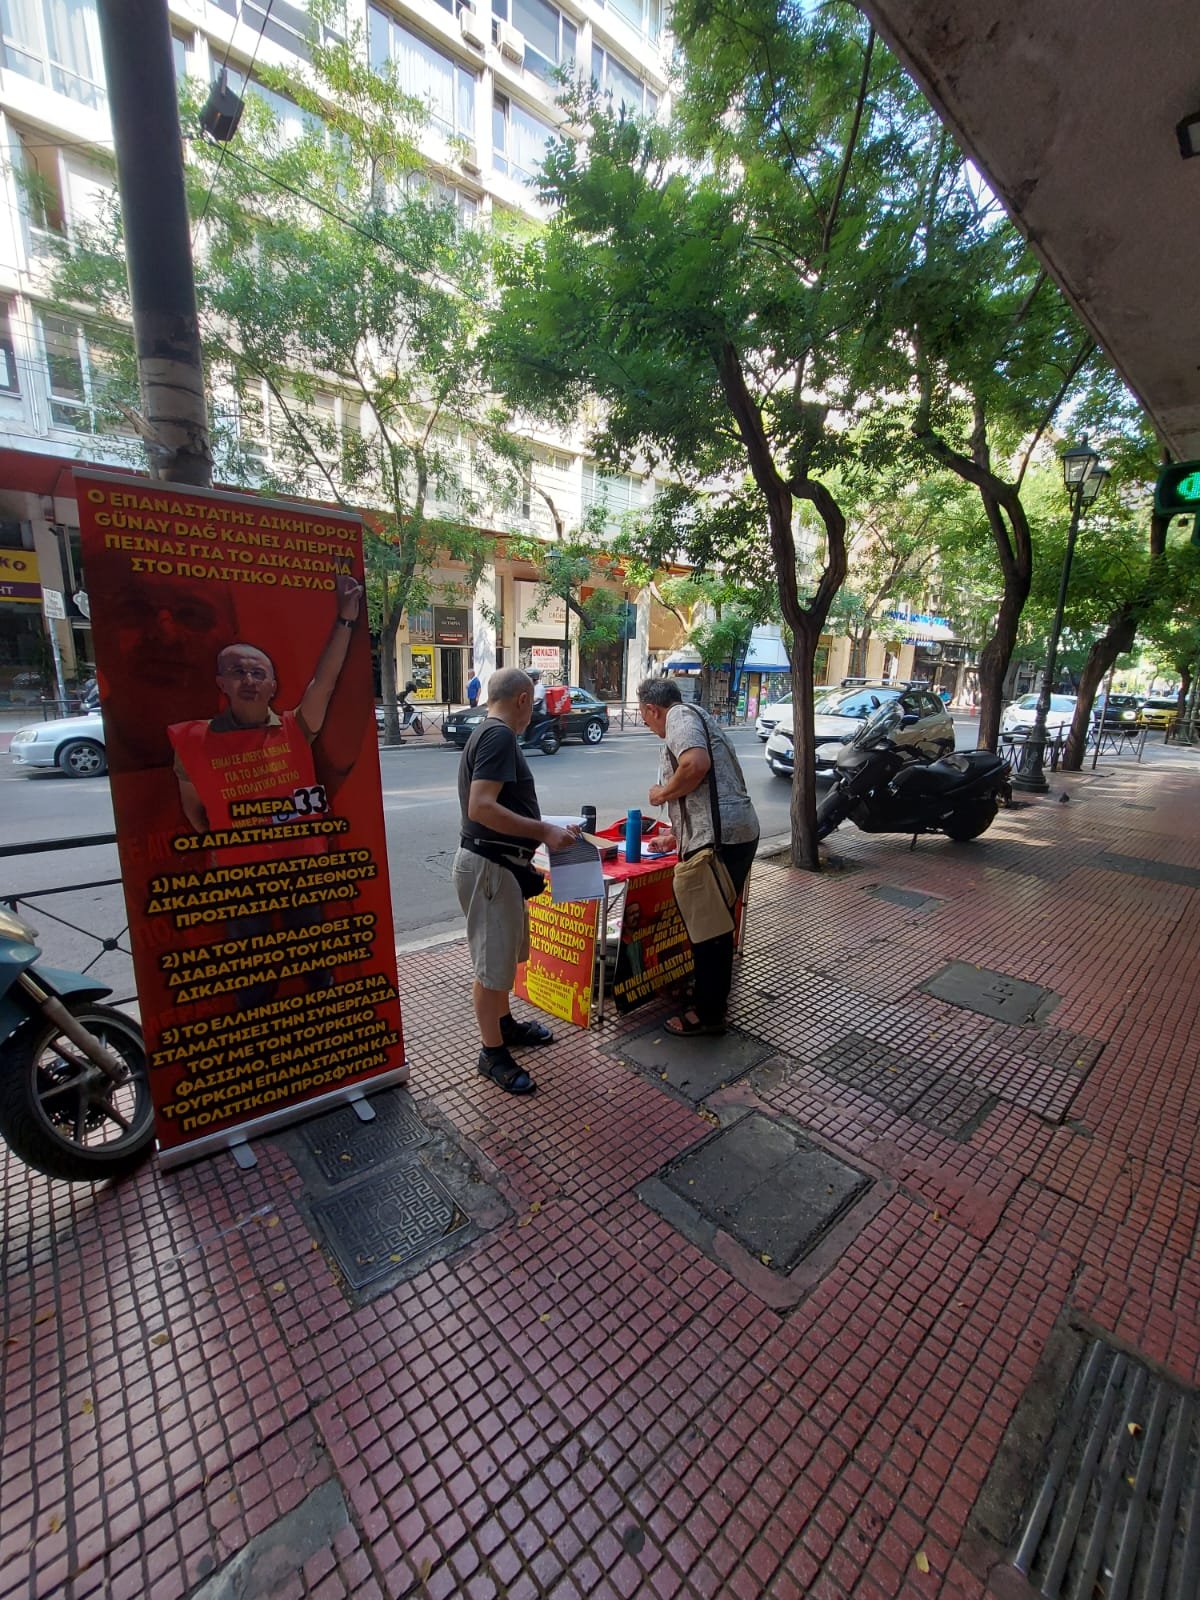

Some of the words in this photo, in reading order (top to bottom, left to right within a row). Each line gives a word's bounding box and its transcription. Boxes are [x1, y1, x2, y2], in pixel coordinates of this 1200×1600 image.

[87, 489, 104, 504] Ο
[110, 492, 255, 527] ΕΠΑΝΑΣΤΑΤΗΣ
[258, 516, 357, 542] ΔΙΚΗΓΟΡΟΣ
[104, 534, 186, 556] ΠΕΙΝΑΣ
[190, 543, 224, 561] ΓΙΑ
[227, 548, 253, 564] ΤΟ
[257, 554, 352, 576] ΔΙΚΑΙΩΜΑ
[221, 528, 281, 548] ΚΑΝΕΙ
[283, 537, 355, 559] ΑΠΕΡΓΙΑ
[132, 556, 173, 575] ΣΤΟ
[177, 562, 276, 585] ΠΟΛΙΤΙΚΟ
[281, 574, 336, 591] ΑΣΥΛΟ
[232, 800, 294, 816] ΗΜΕΡΑ
[174, 835, 199, 850] ΟΙ
[202, 824, 310, 848] ΑΠΑΙΤΗΣΕΙΣ
[313, 820, 348, 833] ΤΟΥ:
[148, 886, 254, 914] ΔΙΚΑΙΩΜΑ
[256, 879, 294, 895] ΤΟΥ,
[295, 865, 376, 889] ΔΙΕΘΝΟΥΣ
[152, 876, 169, 893] 1)
[172, 875, 200, 890] ΝΑ
[203, 855, 347, 886] ΑΠΟΚΑΤΑΣΤΑΘΕΙ
[350, 850, 369, 863] ΤΟ
[176, 897, 290, 928] ΠΡΟΣΤΑΣΙΑΣ
[560, 916, 594, 938] ΚΡΑΤΟΥΣ
[570, 903, 586, 918] ΤΟΥ
[162, 952, 180, 969] 2)
[182, 948, 210, 964] ΝΑ
[212, 940, 249, 957] ΤΟΥ
[252, 919, 350, 950] ΠΑΡΑΔΟΘΕΙ
[354, 914, 374, 928] ΤΟ
[168, 949, 285, 986] ΔΙΑΒΑΤΗΡΙΟ
[286, 942, 320, 959] ΤΟΥ
[322, 936, 351, 950] ΚΑΙ
[353, 930, 374, 944] ΤΟ
[550, 926, 586, 951] ΦΑΣΙΣΜΟ
[176, 970, 278, 1004] ΔΙΚΑΙΩΜΑ
[280, 947, 371, 977] ΔΙΑΜΟΝΗΣ.
[152, 1025, 270, 1066] ΣΤΑΜΑΤΗΣΕΙ
[271, 1014, 305, 1033] ΤΗΝ
[306, 988, 396, 1022] ΣΥΝΕΡΓΑΣΙΑ
[162, 1027, 180, 1045] 3)
[182, 1022, 208, 1037] ΤΟ
[210, 996, 302, 1029] ΕΛΛΗΝΙΚΟ
[304, 981, 364, 1005] ΚΡΑΤΟΣ
[366, 975, 387, 988] ΝΑ
[176, 1059, 270, 1098] ΦΑΣΙΣΜΟ,
[270, 1032, 354, 1066] ΕΝΑΝΤΙΟΝ
[355, 1021, 386, 1039] ΤΩΝ
[187, 1054, 227, 1074] ΤΟΥ
[228, 1046, 254, 1062] ΜΕ
[256, 1034, 292, 1055] ΤΟΝ
[293, 1010, 374, 1041] ΤΟΥΡΚΙΚΟ
[163, 1080, 254, 1118] ΤΟΥΡΚΩΝ
[255, 1042, 368, 1089] ΕΠΑΝΑΣΤΑΤΩΝ
[370, 1032, 398, 1050] ΚΑΙ
[182, 1087, 289, 1131] ΠΟΛΙΤΙΚΩΝ
[290, 1053, 387, 1093] ΠΡΟΣΦΥΓΩΝ.
